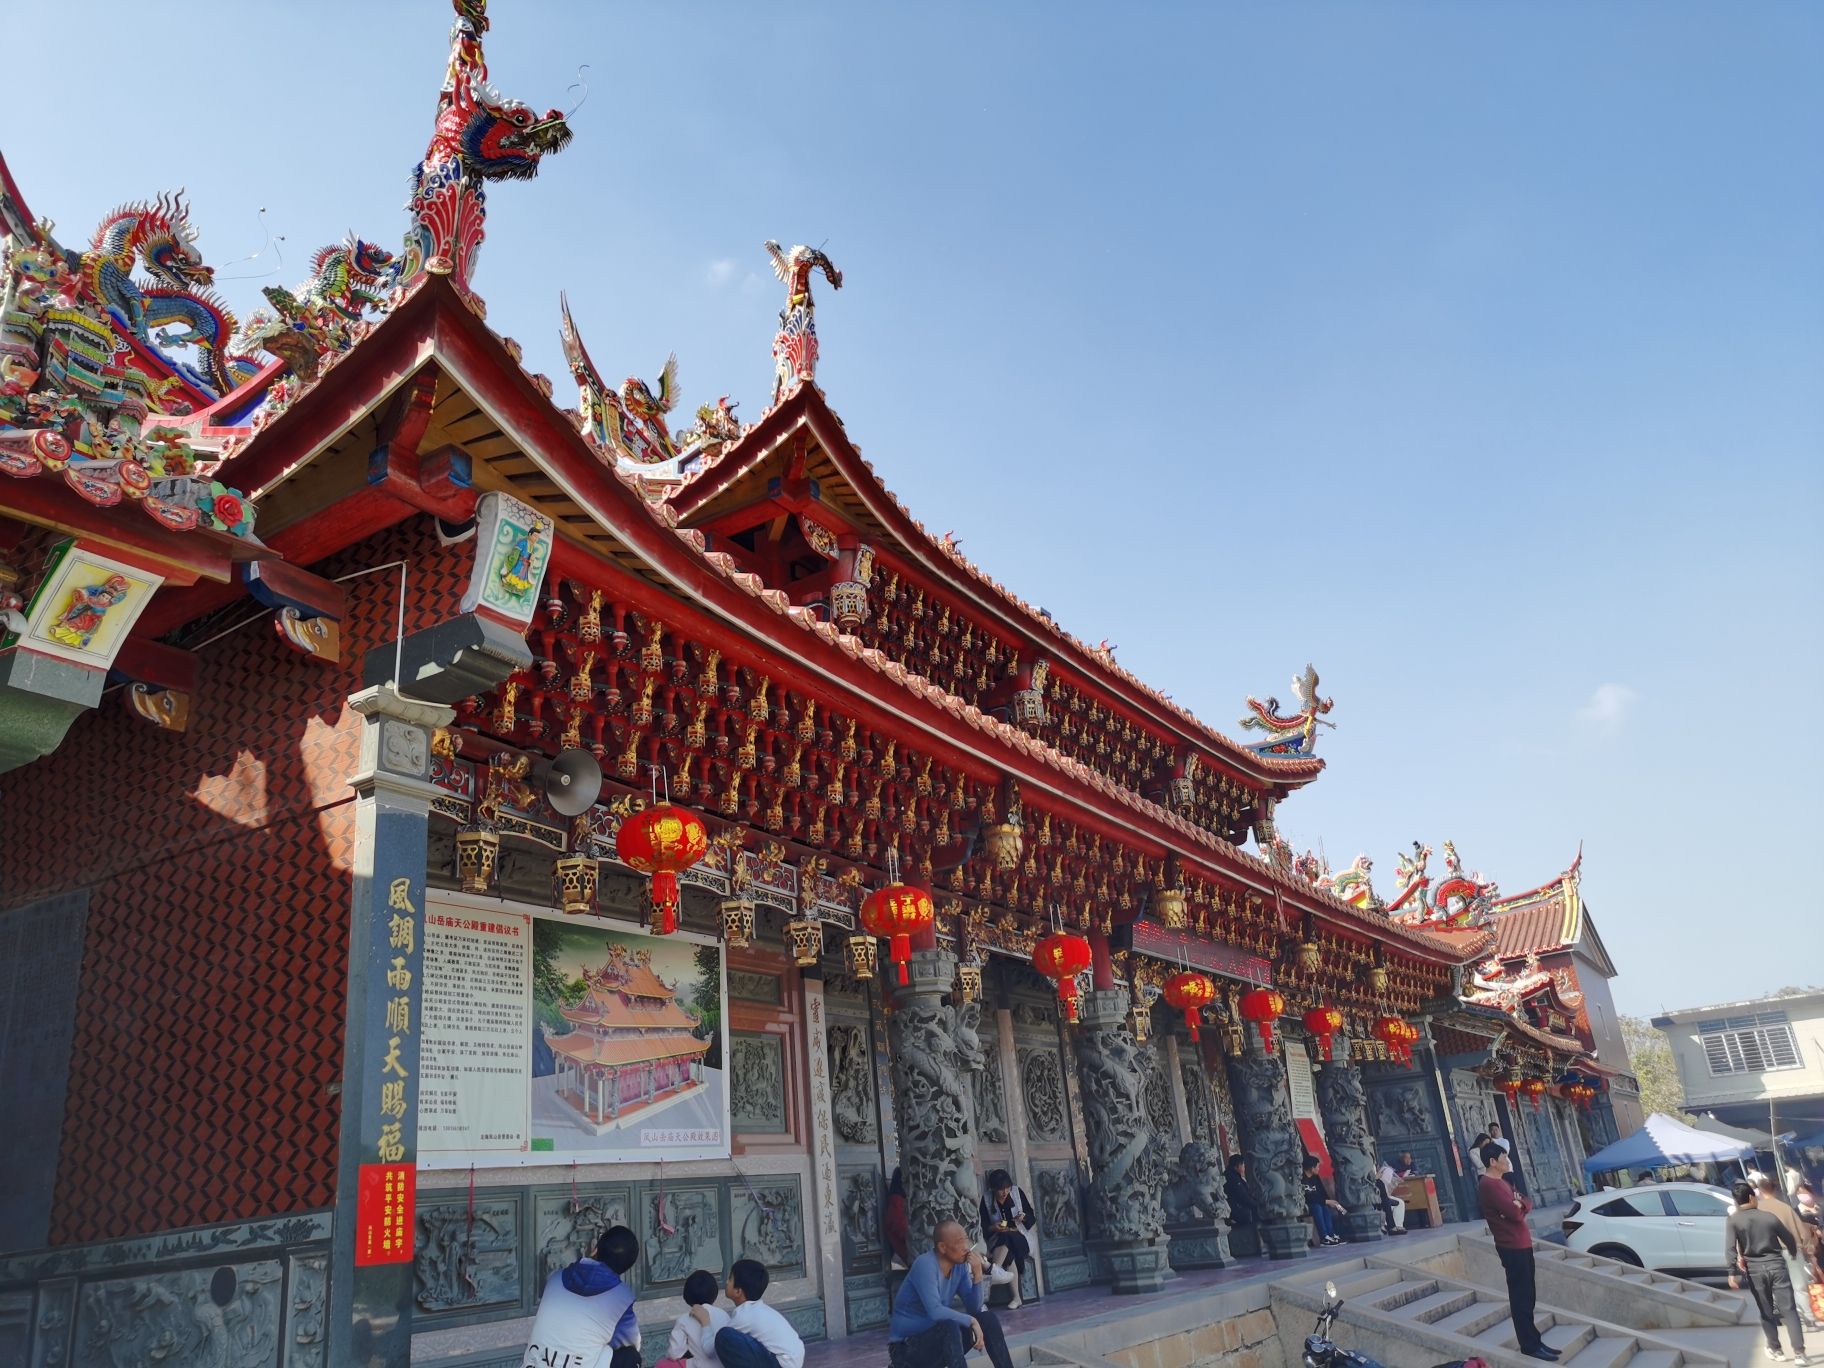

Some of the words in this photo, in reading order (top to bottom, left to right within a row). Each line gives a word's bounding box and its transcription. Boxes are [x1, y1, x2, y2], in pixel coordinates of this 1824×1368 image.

[377, 877, 416, 1165] 風調雨順天賜福
